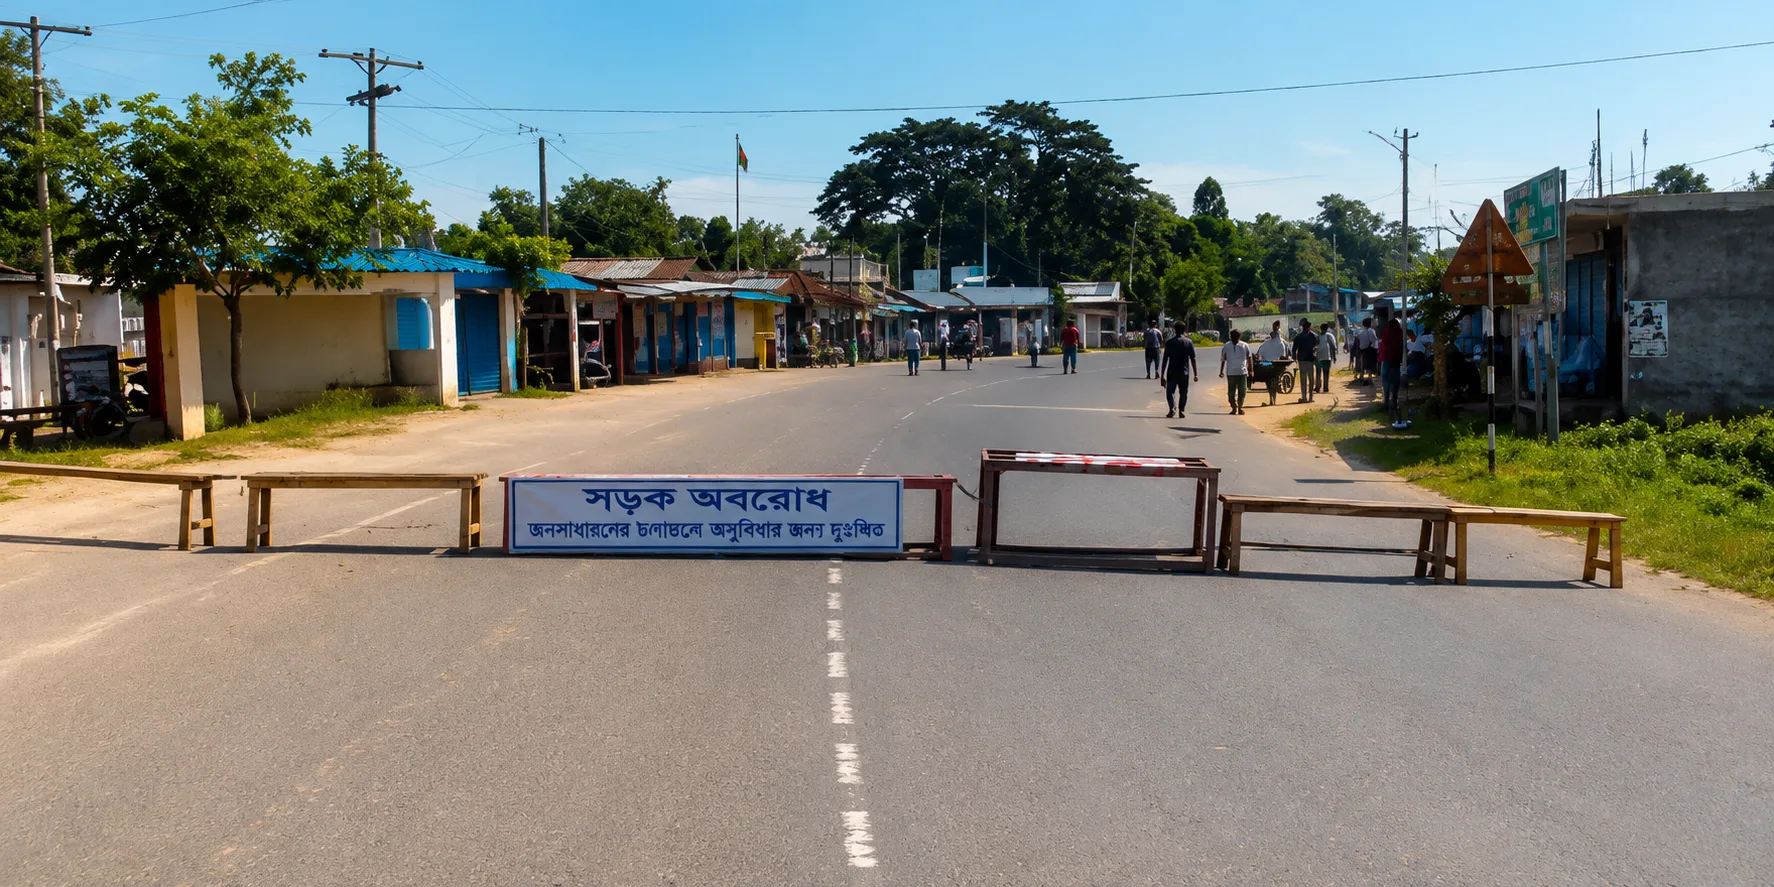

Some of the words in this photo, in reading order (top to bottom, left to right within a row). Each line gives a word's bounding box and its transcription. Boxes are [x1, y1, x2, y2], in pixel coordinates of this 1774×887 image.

[582, 488, 677, 516] সড়ক
[686, 486, 832, 513] অবরোধ
[709, 518, 783, 543] অসুবিধার
